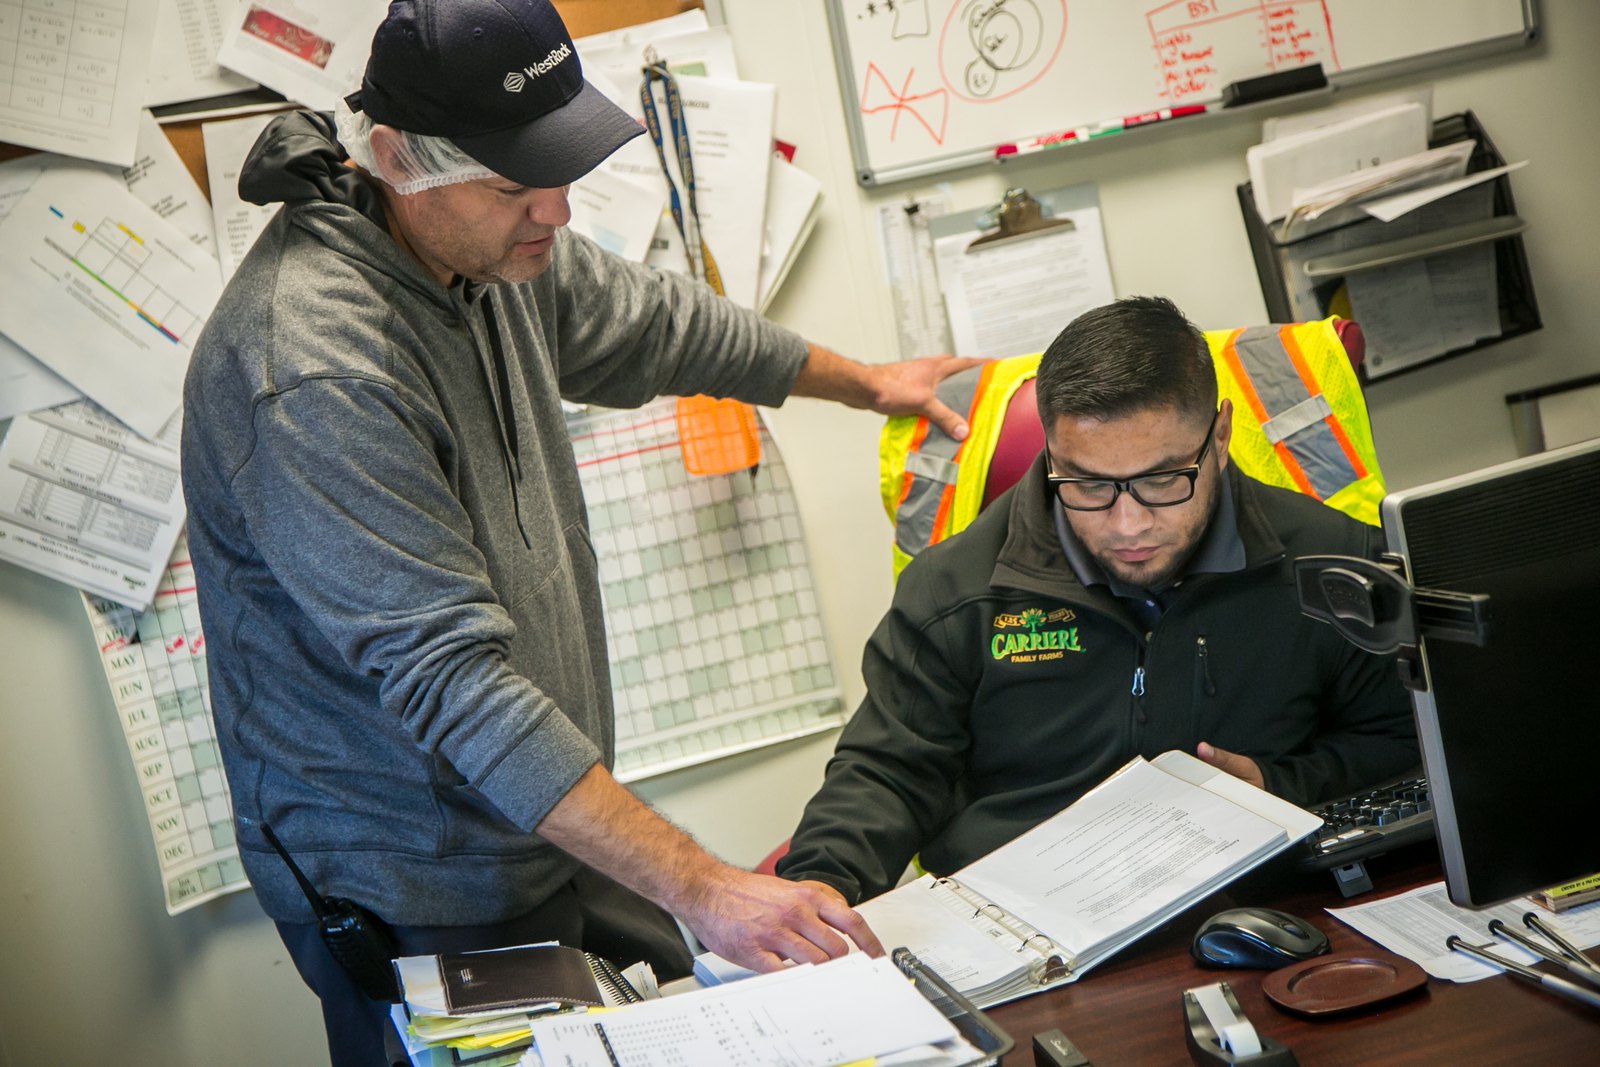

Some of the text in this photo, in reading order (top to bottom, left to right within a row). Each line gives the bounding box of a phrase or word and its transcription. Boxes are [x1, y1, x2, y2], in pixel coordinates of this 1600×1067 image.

[523, 42, 572, 80] WestRock
[990, 627, 1081, 660] CARRIERE
[110, 653, 136, 670] MAY
[1011, 651, 1064, 663] FAMILY FARMS
[119, 681, 143, 699] JUN
[127, 709, 149, 728] JUL
[134, 735, 159, 752] AUG
[142, 762, 163, 779] SEP
[149, 788, 172, 807] OCT
[156, 815, 179, 833] NOV
[163, 842, 187, 861] DEC
